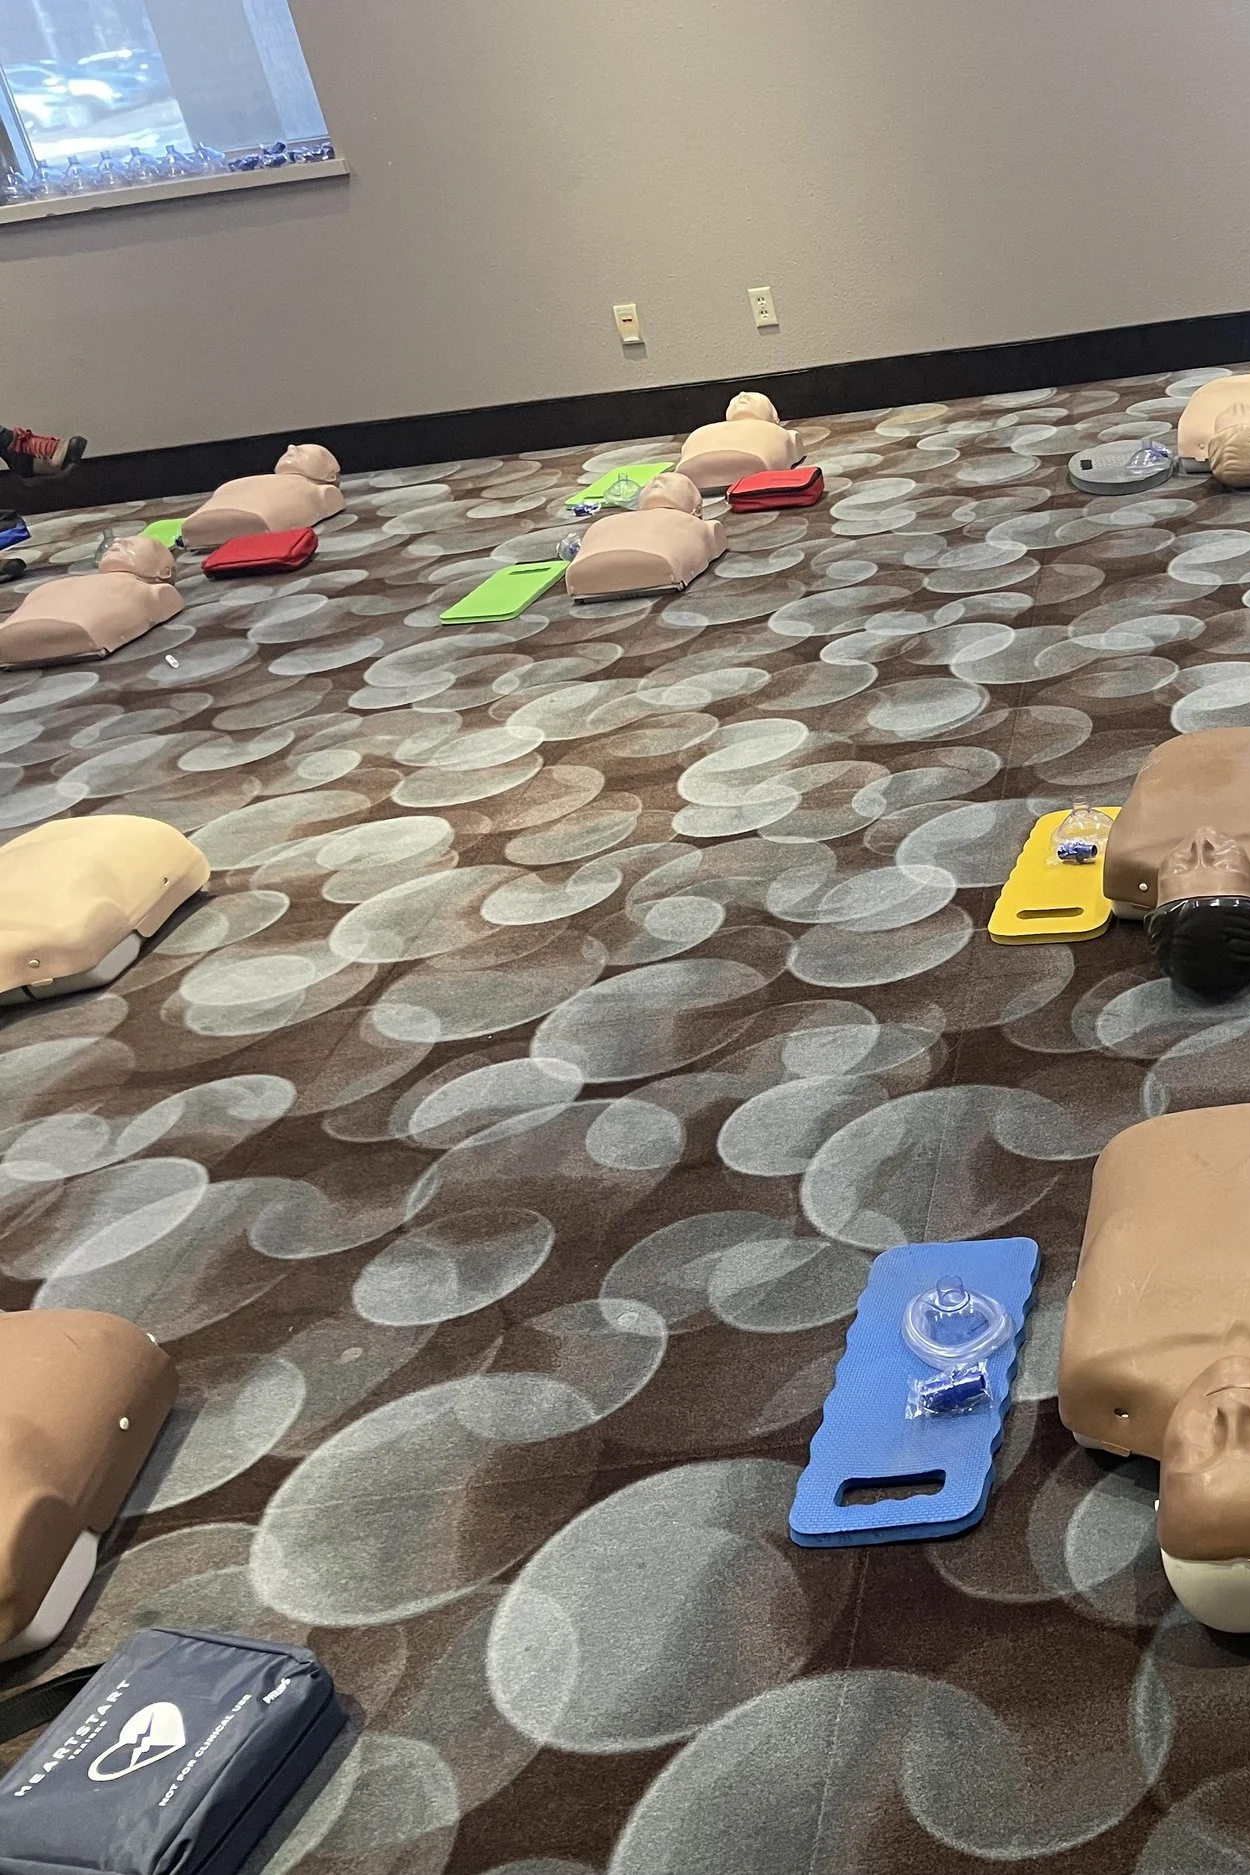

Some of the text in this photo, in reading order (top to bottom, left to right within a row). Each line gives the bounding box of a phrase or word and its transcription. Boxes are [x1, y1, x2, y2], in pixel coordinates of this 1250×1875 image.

[14, 1680, 130, 1796] HEARTSTART
[158, 1693, 253, 1807] NOT FOR CLINICAL USE
